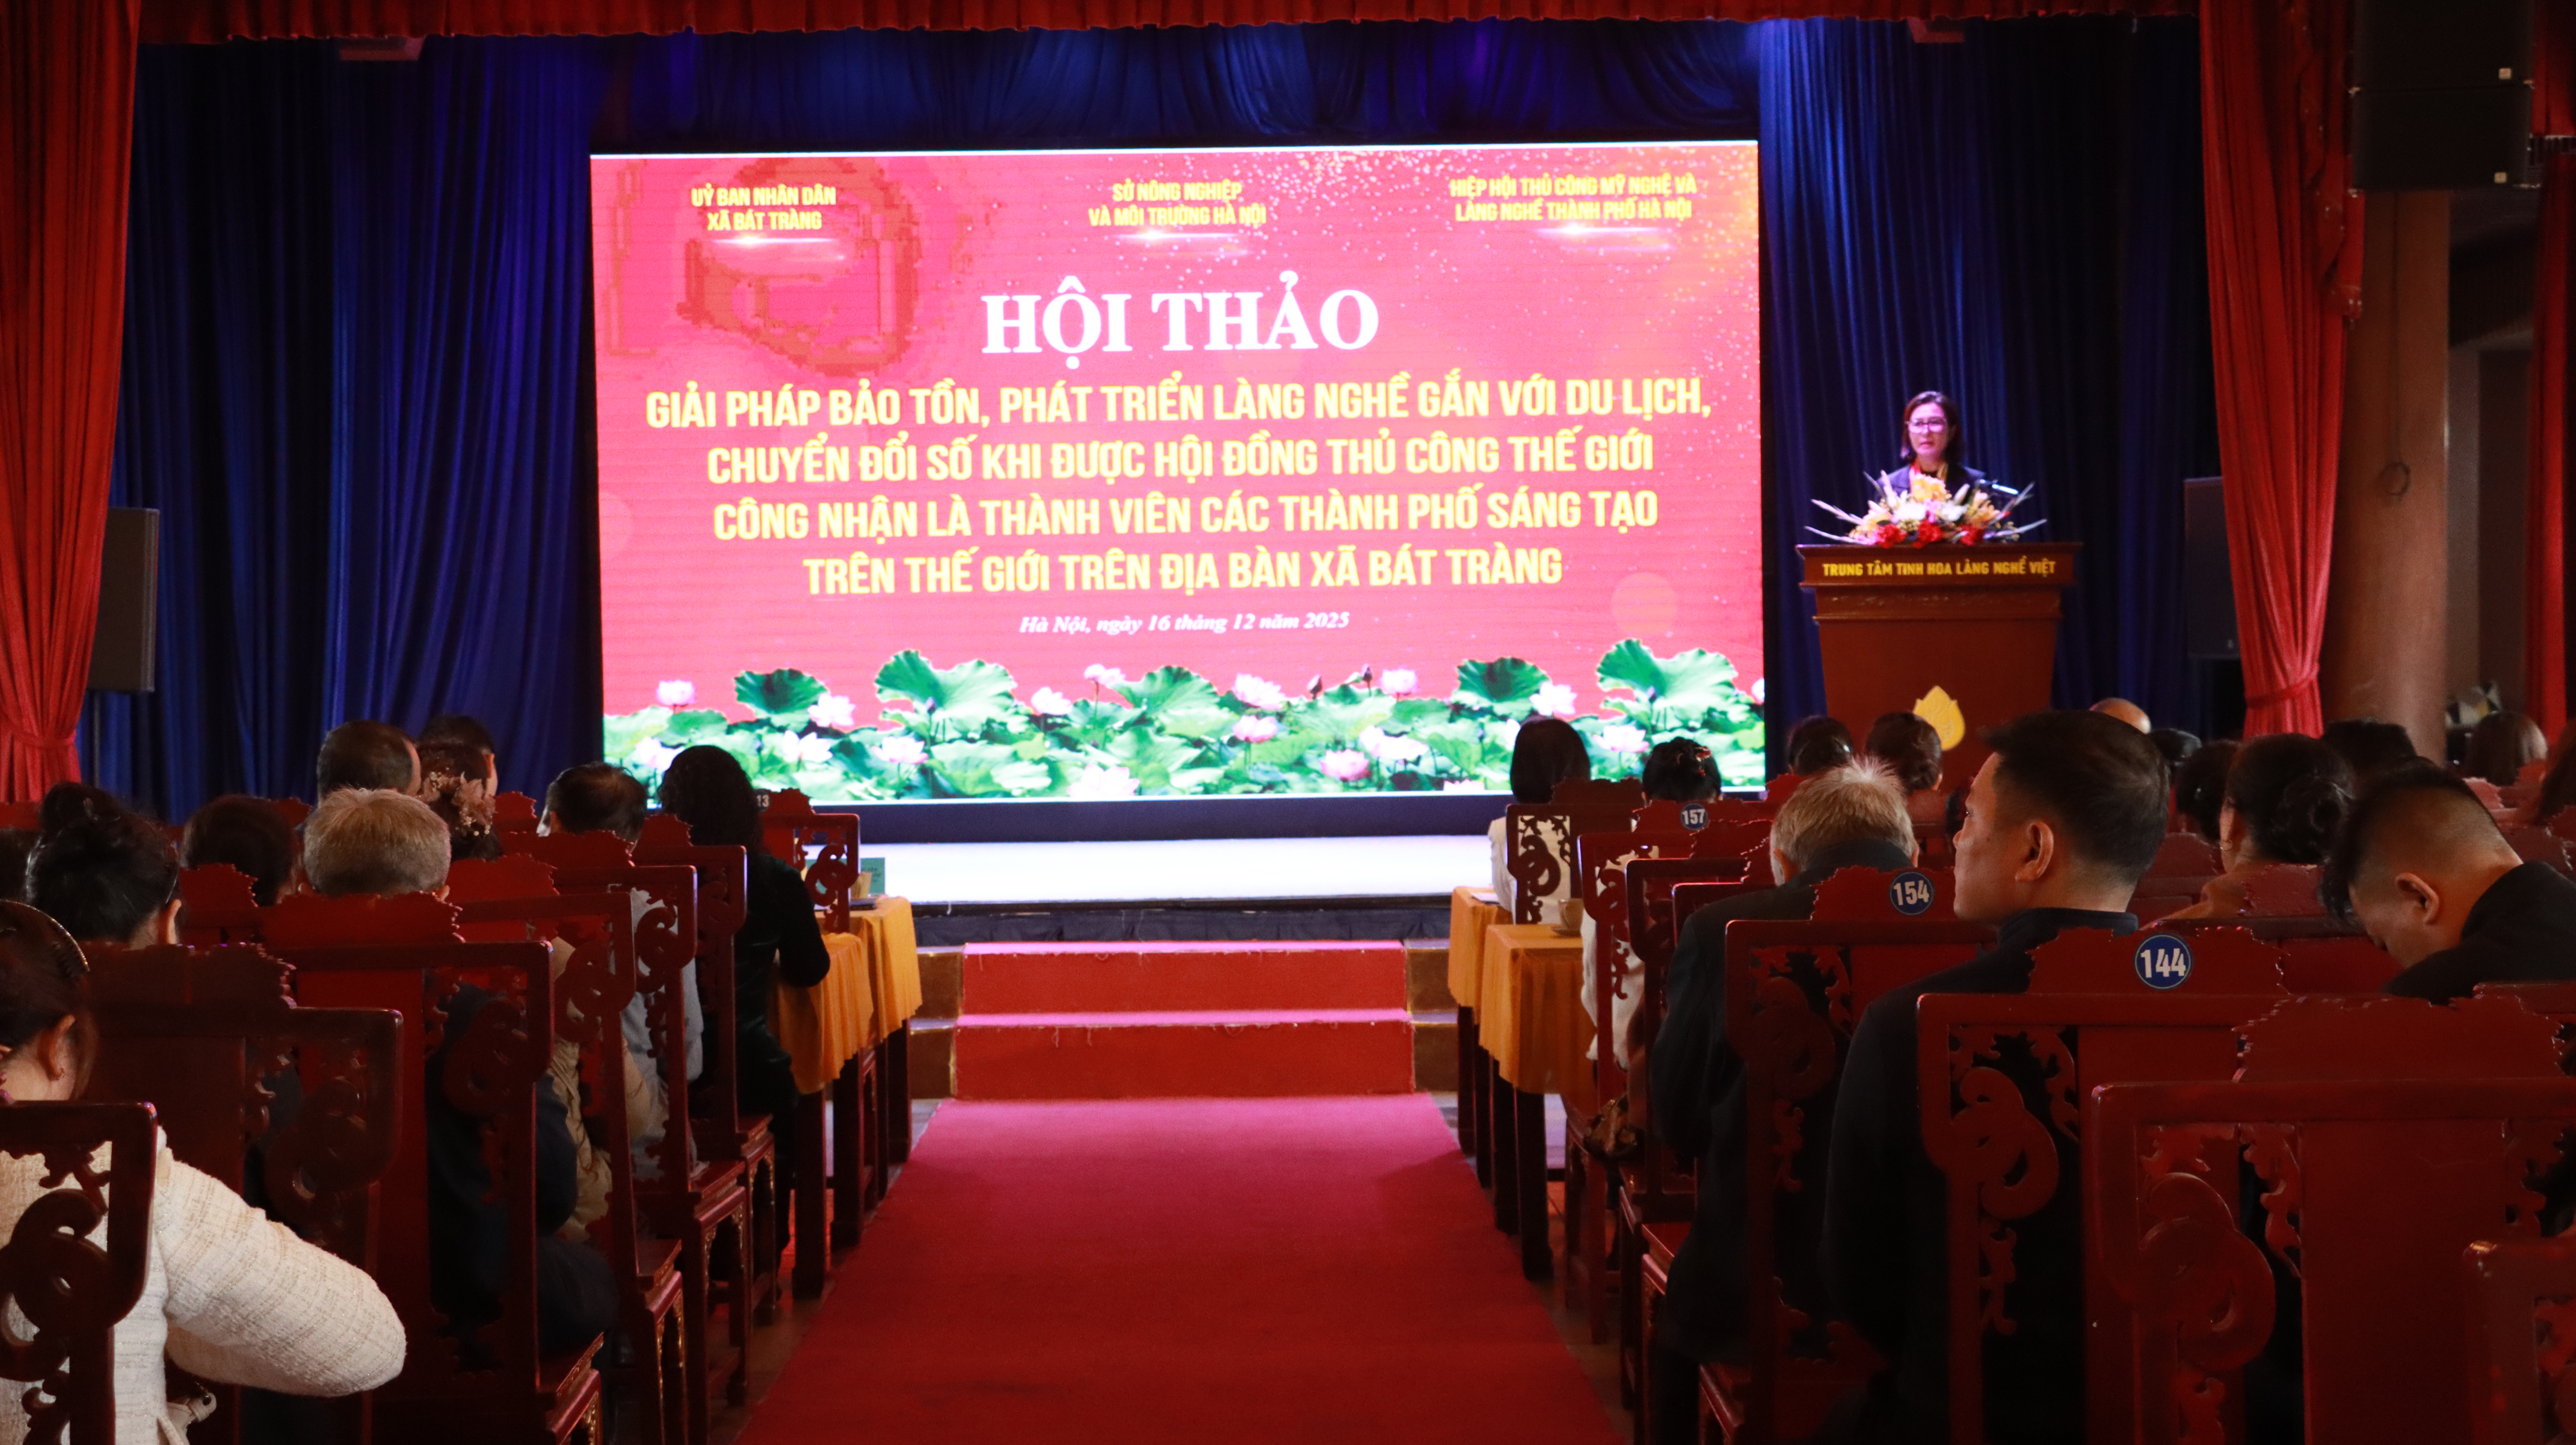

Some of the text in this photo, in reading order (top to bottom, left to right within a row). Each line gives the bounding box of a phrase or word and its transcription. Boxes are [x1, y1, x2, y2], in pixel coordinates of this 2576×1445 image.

[717, 188, 751, 205] BAN
[753, 184, 799, 204] NHÂN
[801, 184, 836, 204] DÂN
[1113, 178, 1241, 202] SỞ NÔNG NGHIỆP
[1451, 176, 1486, 201] HIỆP
[1489, 175, 1517, 198] HỘI
[1520, 173, 1552, 195] THỦ
[1555, 174, 1597, 195] CÔNG
[1600, 174, 1625, 194] MỸ
[1674, 172, 1697, 193] VÀ
[707, 208, 822, 230] XÃ BÁT TRÀNG
[1089, 202, 1267, 227] VÀ MÔI TRƯỜNG HÀ NỘI
[1456, 197, 1692, 221] LÀNG NGHỀ THÀNH PHỐ HÀ NỘI
[981, 271, 1378, 369] HỘI THẢO
[647, 368, 1711, 428] GIẢI PHÁP BẢO TỒN, PHÁT TRIỂN LÀNG NGHỀ GẮN VỚI DU LỊCH,
[708, 425, 1653, 485] CHUYỂN ĐỔI SỐ KHI ĐƯỢC HỘI ĐỒNG THỦ CÔNG THẾ GIỚI
[714, 483, 1657, 544] CÔNG NHẬN LÀ THÀNH VIÊN CÁC THÀNH PHỐ SÁNG TẠO
[803, 542, 1562, 596] TRÊN THẾ GIỚI TRÊN ĐỊA BÀN XÃ BÁT TRÀNG
[1823, 564, 1863, 576] TRUNG
[1867, 560, 1892, 575] TÂM
[1927, 563, 1952, 574] HOA
[1956, 558, 1989, 575] LÀNG
[1993, 556, 2026, 574] NGHỀ
[2029, 558, 2055, 576] VIỆT
[1020, 612, 1349, 635] Hà Nội, ngày 16 tháng 12 năm 2025
[757, 794, 769, 807] 13
[1682, 809, 1705, 824] 157
[1894, 881, 1929, 905] 154
[2141, 948, 2186, 978] 144
